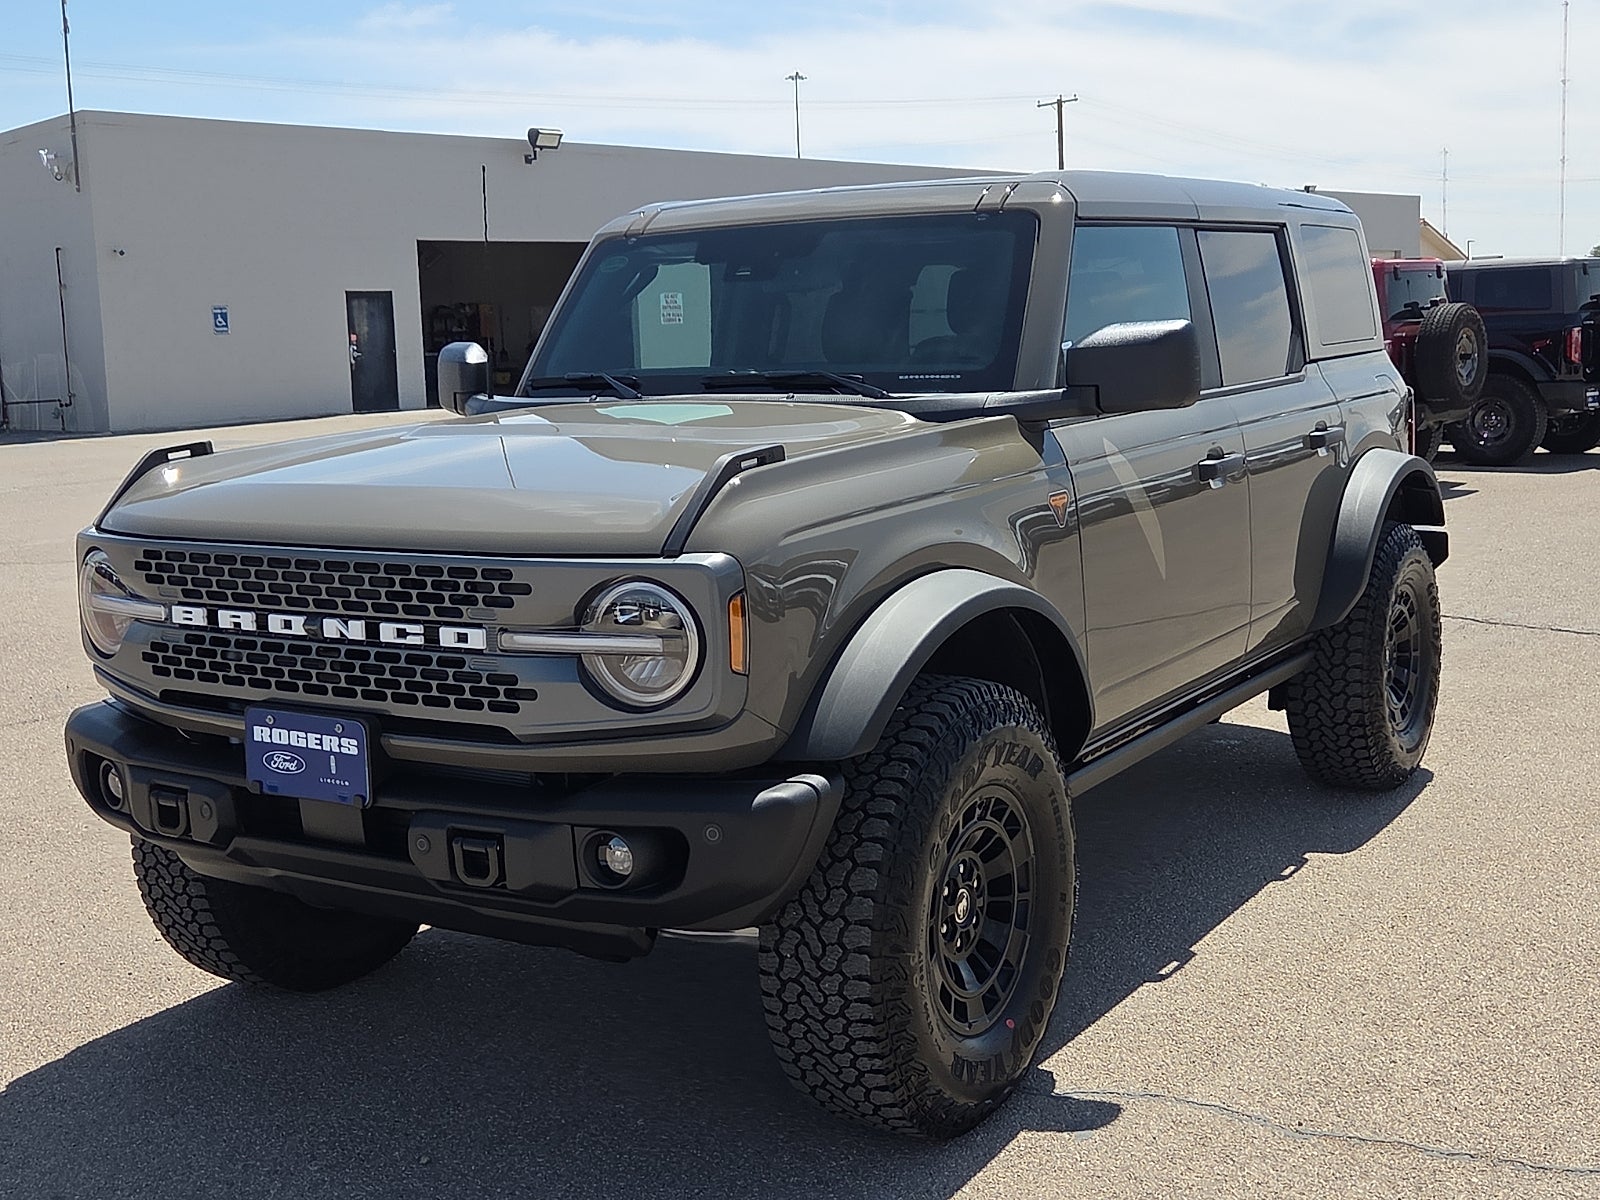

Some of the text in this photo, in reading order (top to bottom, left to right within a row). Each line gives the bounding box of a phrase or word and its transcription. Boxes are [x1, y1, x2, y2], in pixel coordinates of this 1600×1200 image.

[171, 604, 488, 651] BRONCO
[253, 725, 359, 756] ROGERS
[270, 753, 298, 771] Ford
[319, 777, 350, 786] LINCOLN
